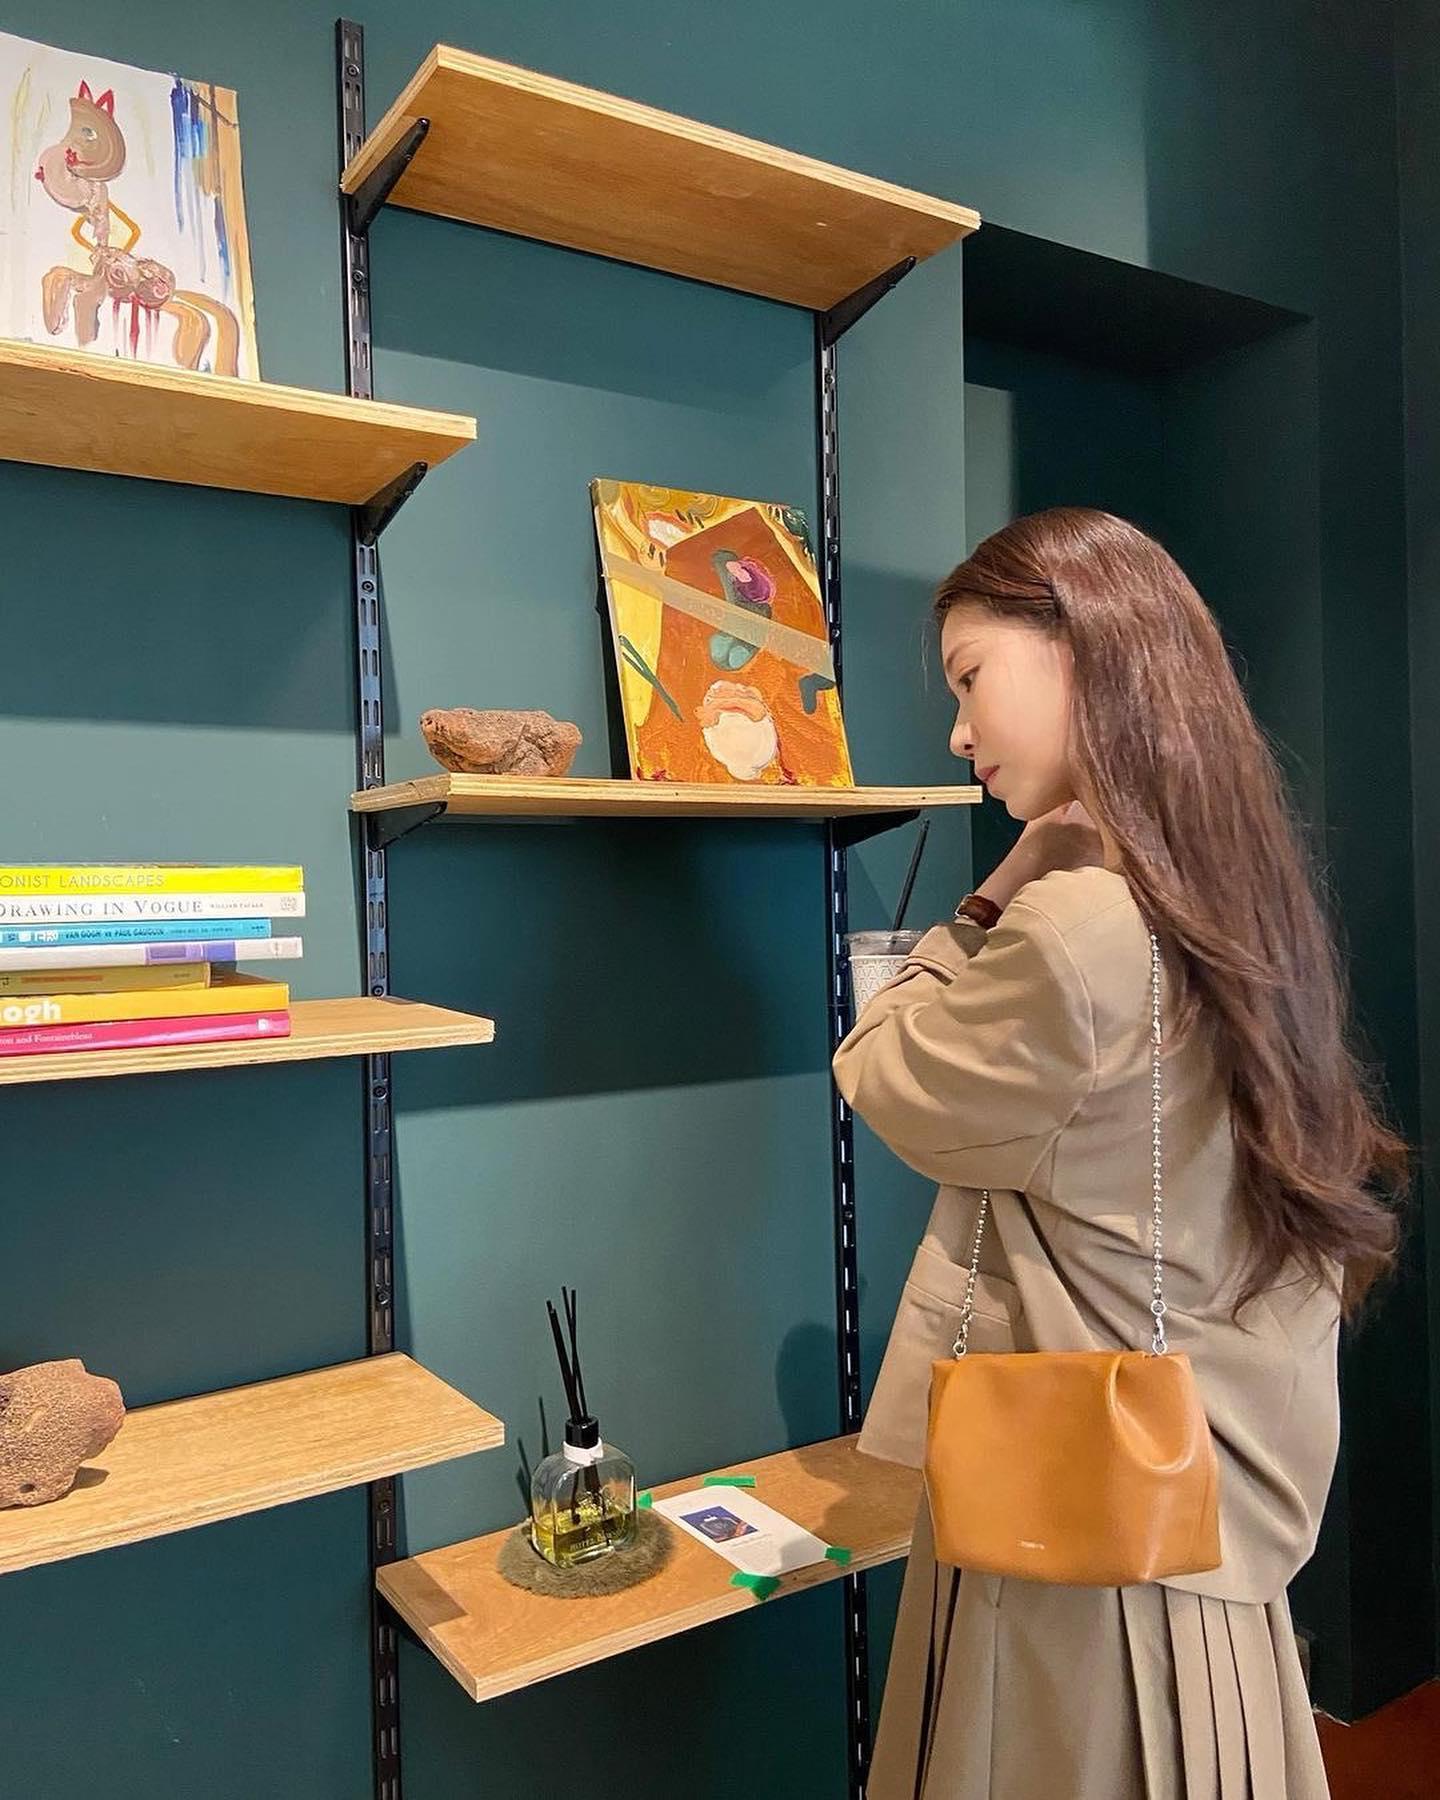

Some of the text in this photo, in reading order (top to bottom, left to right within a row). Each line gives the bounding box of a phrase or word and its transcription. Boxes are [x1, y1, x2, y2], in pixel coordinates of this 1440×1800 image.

[59, 874, 165, 888] LANDSCAPES
[104, 902, 125, 916] IN
[135, 899, 203, 914] VOGUE
[15, 1035, 32, 1045] and
